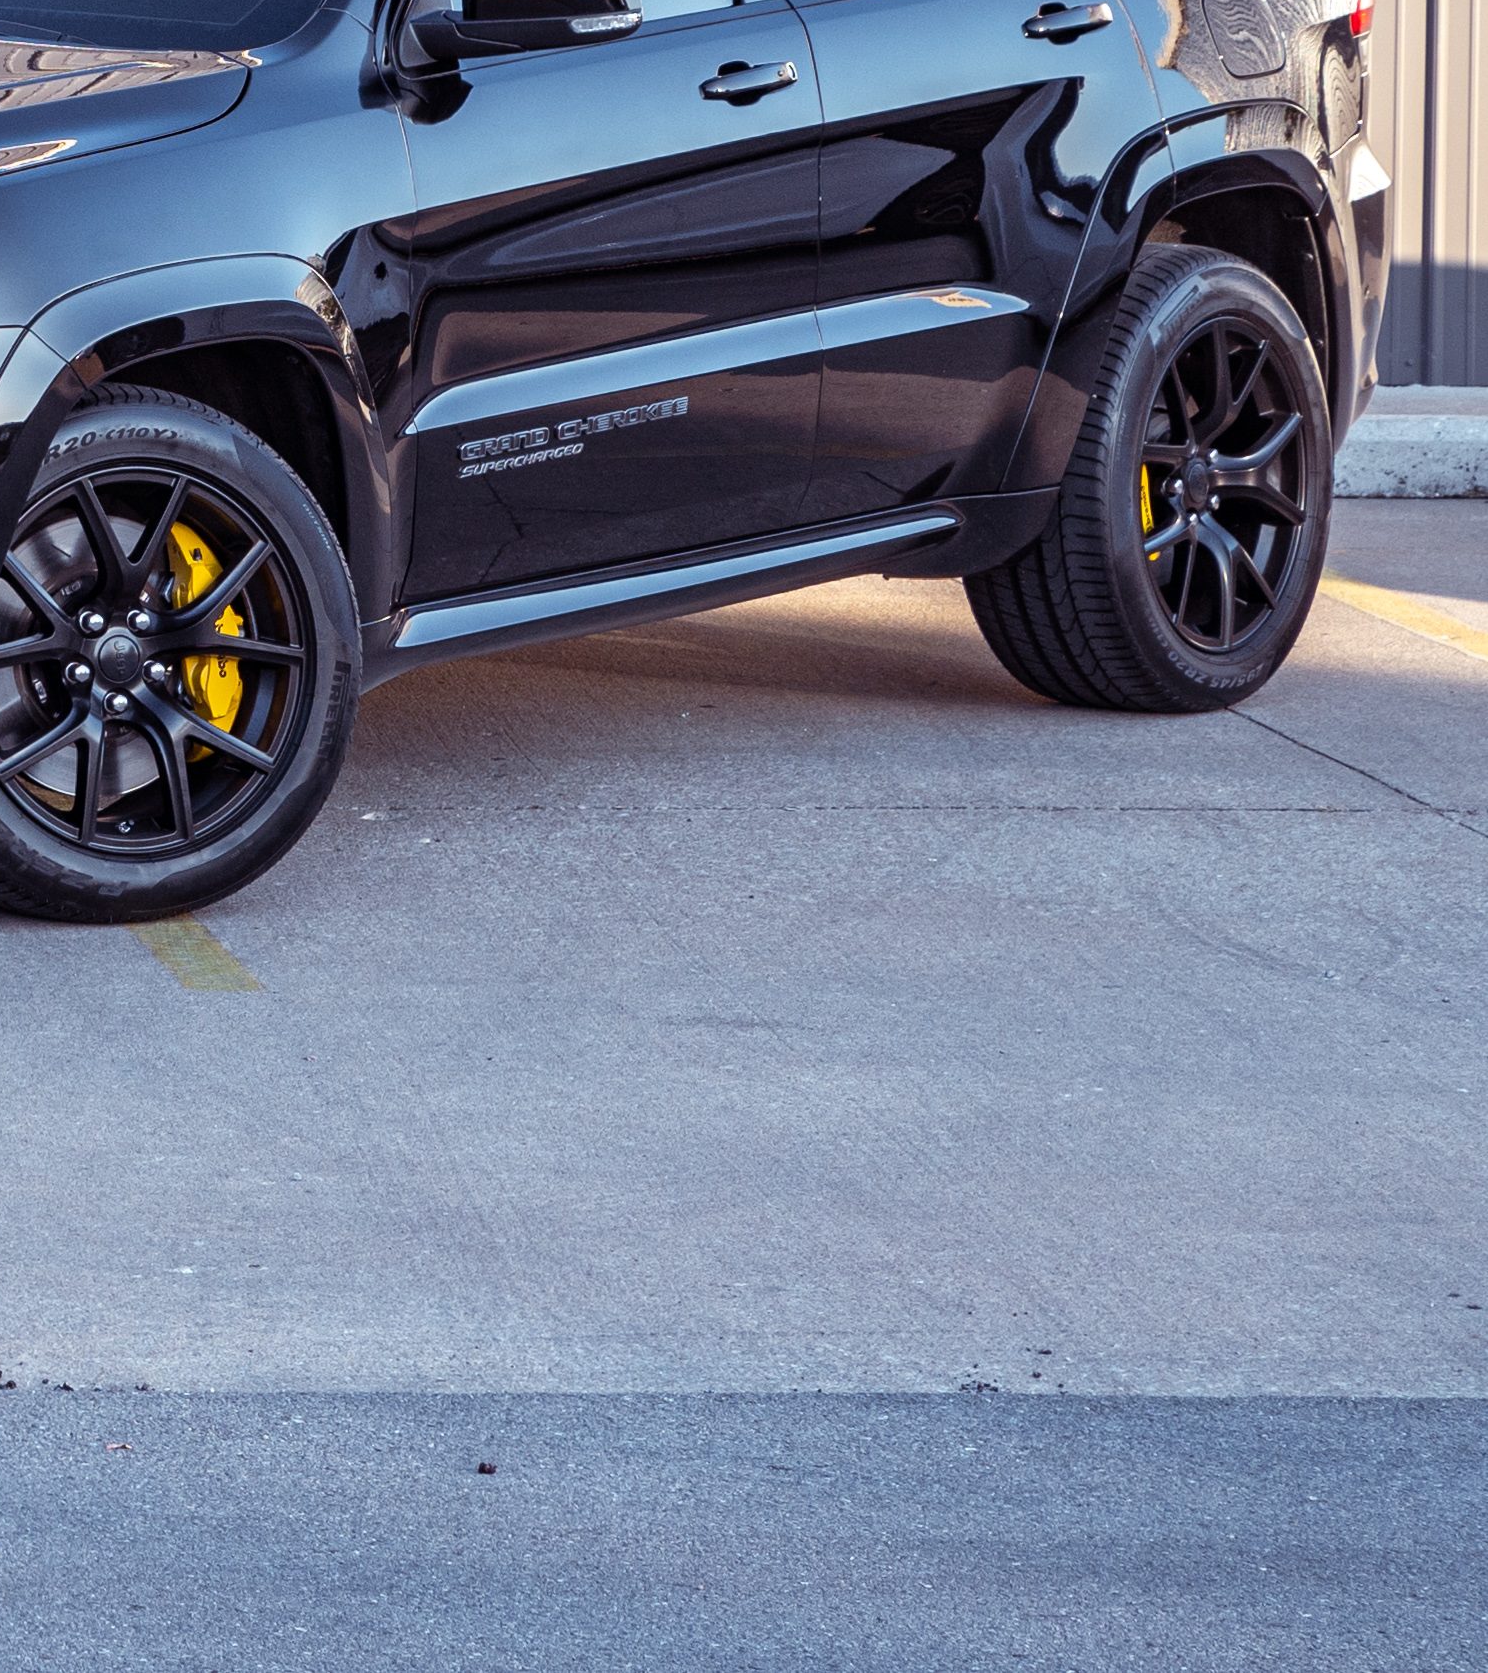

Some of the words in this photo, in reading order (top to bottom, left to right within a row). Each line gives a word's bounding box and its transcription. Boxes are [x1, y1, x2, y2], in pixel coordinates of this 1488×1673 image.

[456, 426, 551, 462] GRAND
[554, 395, 689, 441] CHEROKEE
[455, 442, 585, 479] SUPERCHARGED
